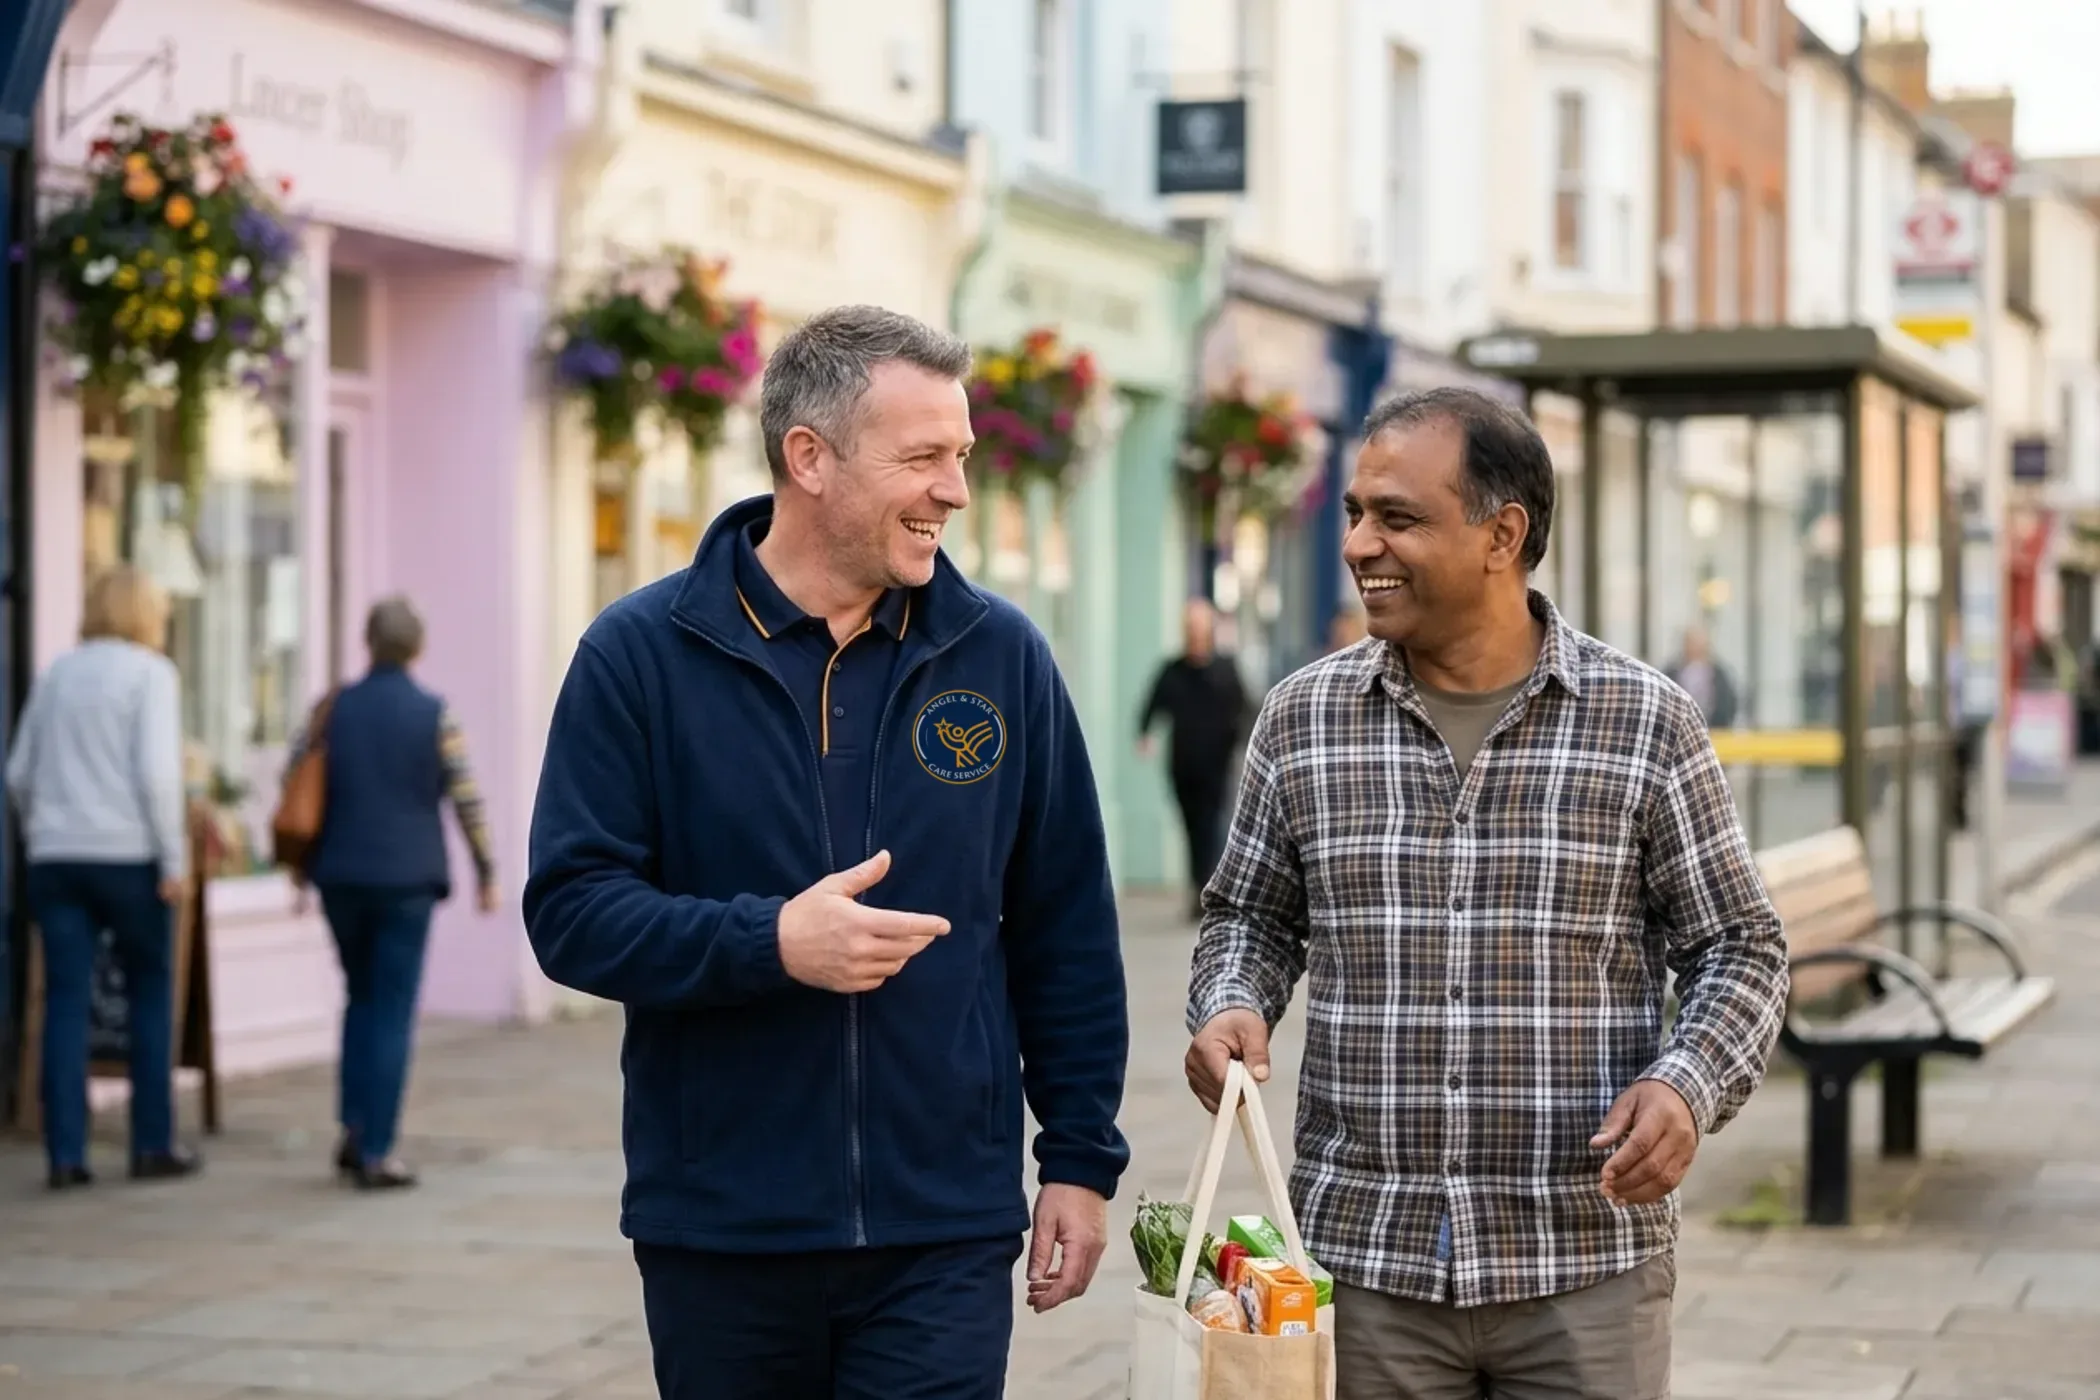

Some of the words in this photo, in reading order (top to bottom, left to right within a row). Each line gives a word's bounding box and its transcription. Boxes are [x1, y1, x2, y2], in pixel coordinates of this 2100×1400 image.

[926, 695, 957, 715] ANGEL
[960, 694, 968, 703] &
[970, 696, 993, 715] STAR
[928, 763, 952, 779] CARE
[953, 763, 991, 780] SERVICE
